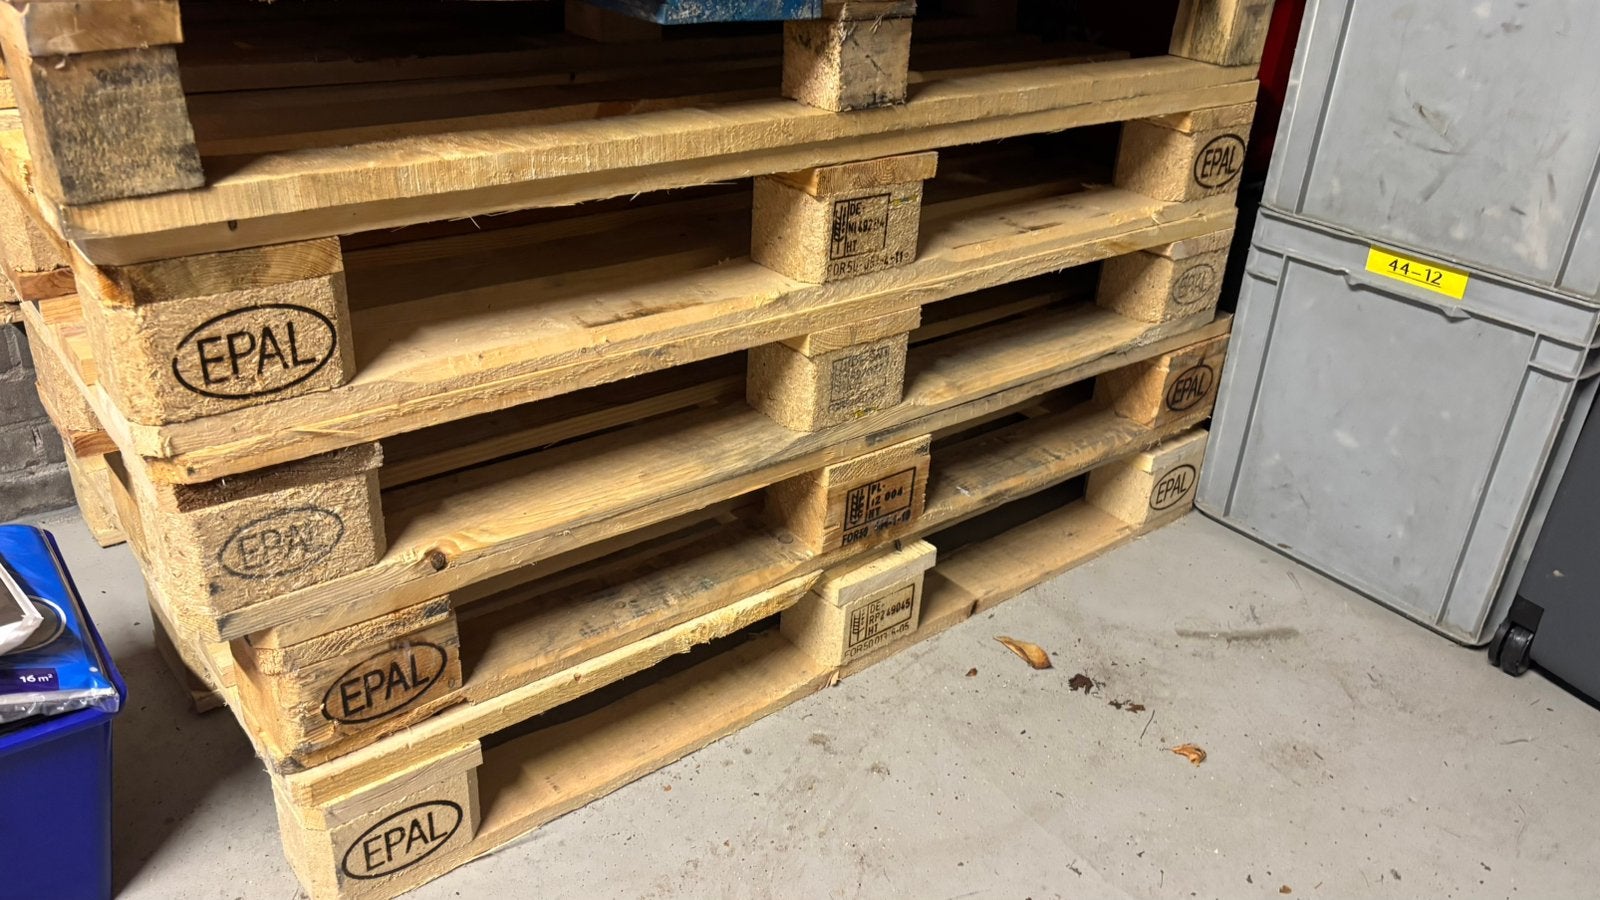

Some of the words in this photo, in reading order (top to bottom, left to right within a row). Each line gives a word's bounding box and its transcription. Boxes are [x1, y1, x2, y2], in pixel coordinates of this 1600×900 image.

[1201, 146, 1236, 179] EPAL
[846, 239, 858, 253] HT
[1388, 259, 1443, 286] 44-12
[197, 321, 317, 386] EPAL
[1171, 371, 1206, 405] EPAL
[1156, 471, 1187, 505] EPAL
[868, 623, 879, 636] HT
[19, 674, 36, 683] 16
[340, 654, 430, 717] EPAL
[363, 811, 448, 872] EPAL
